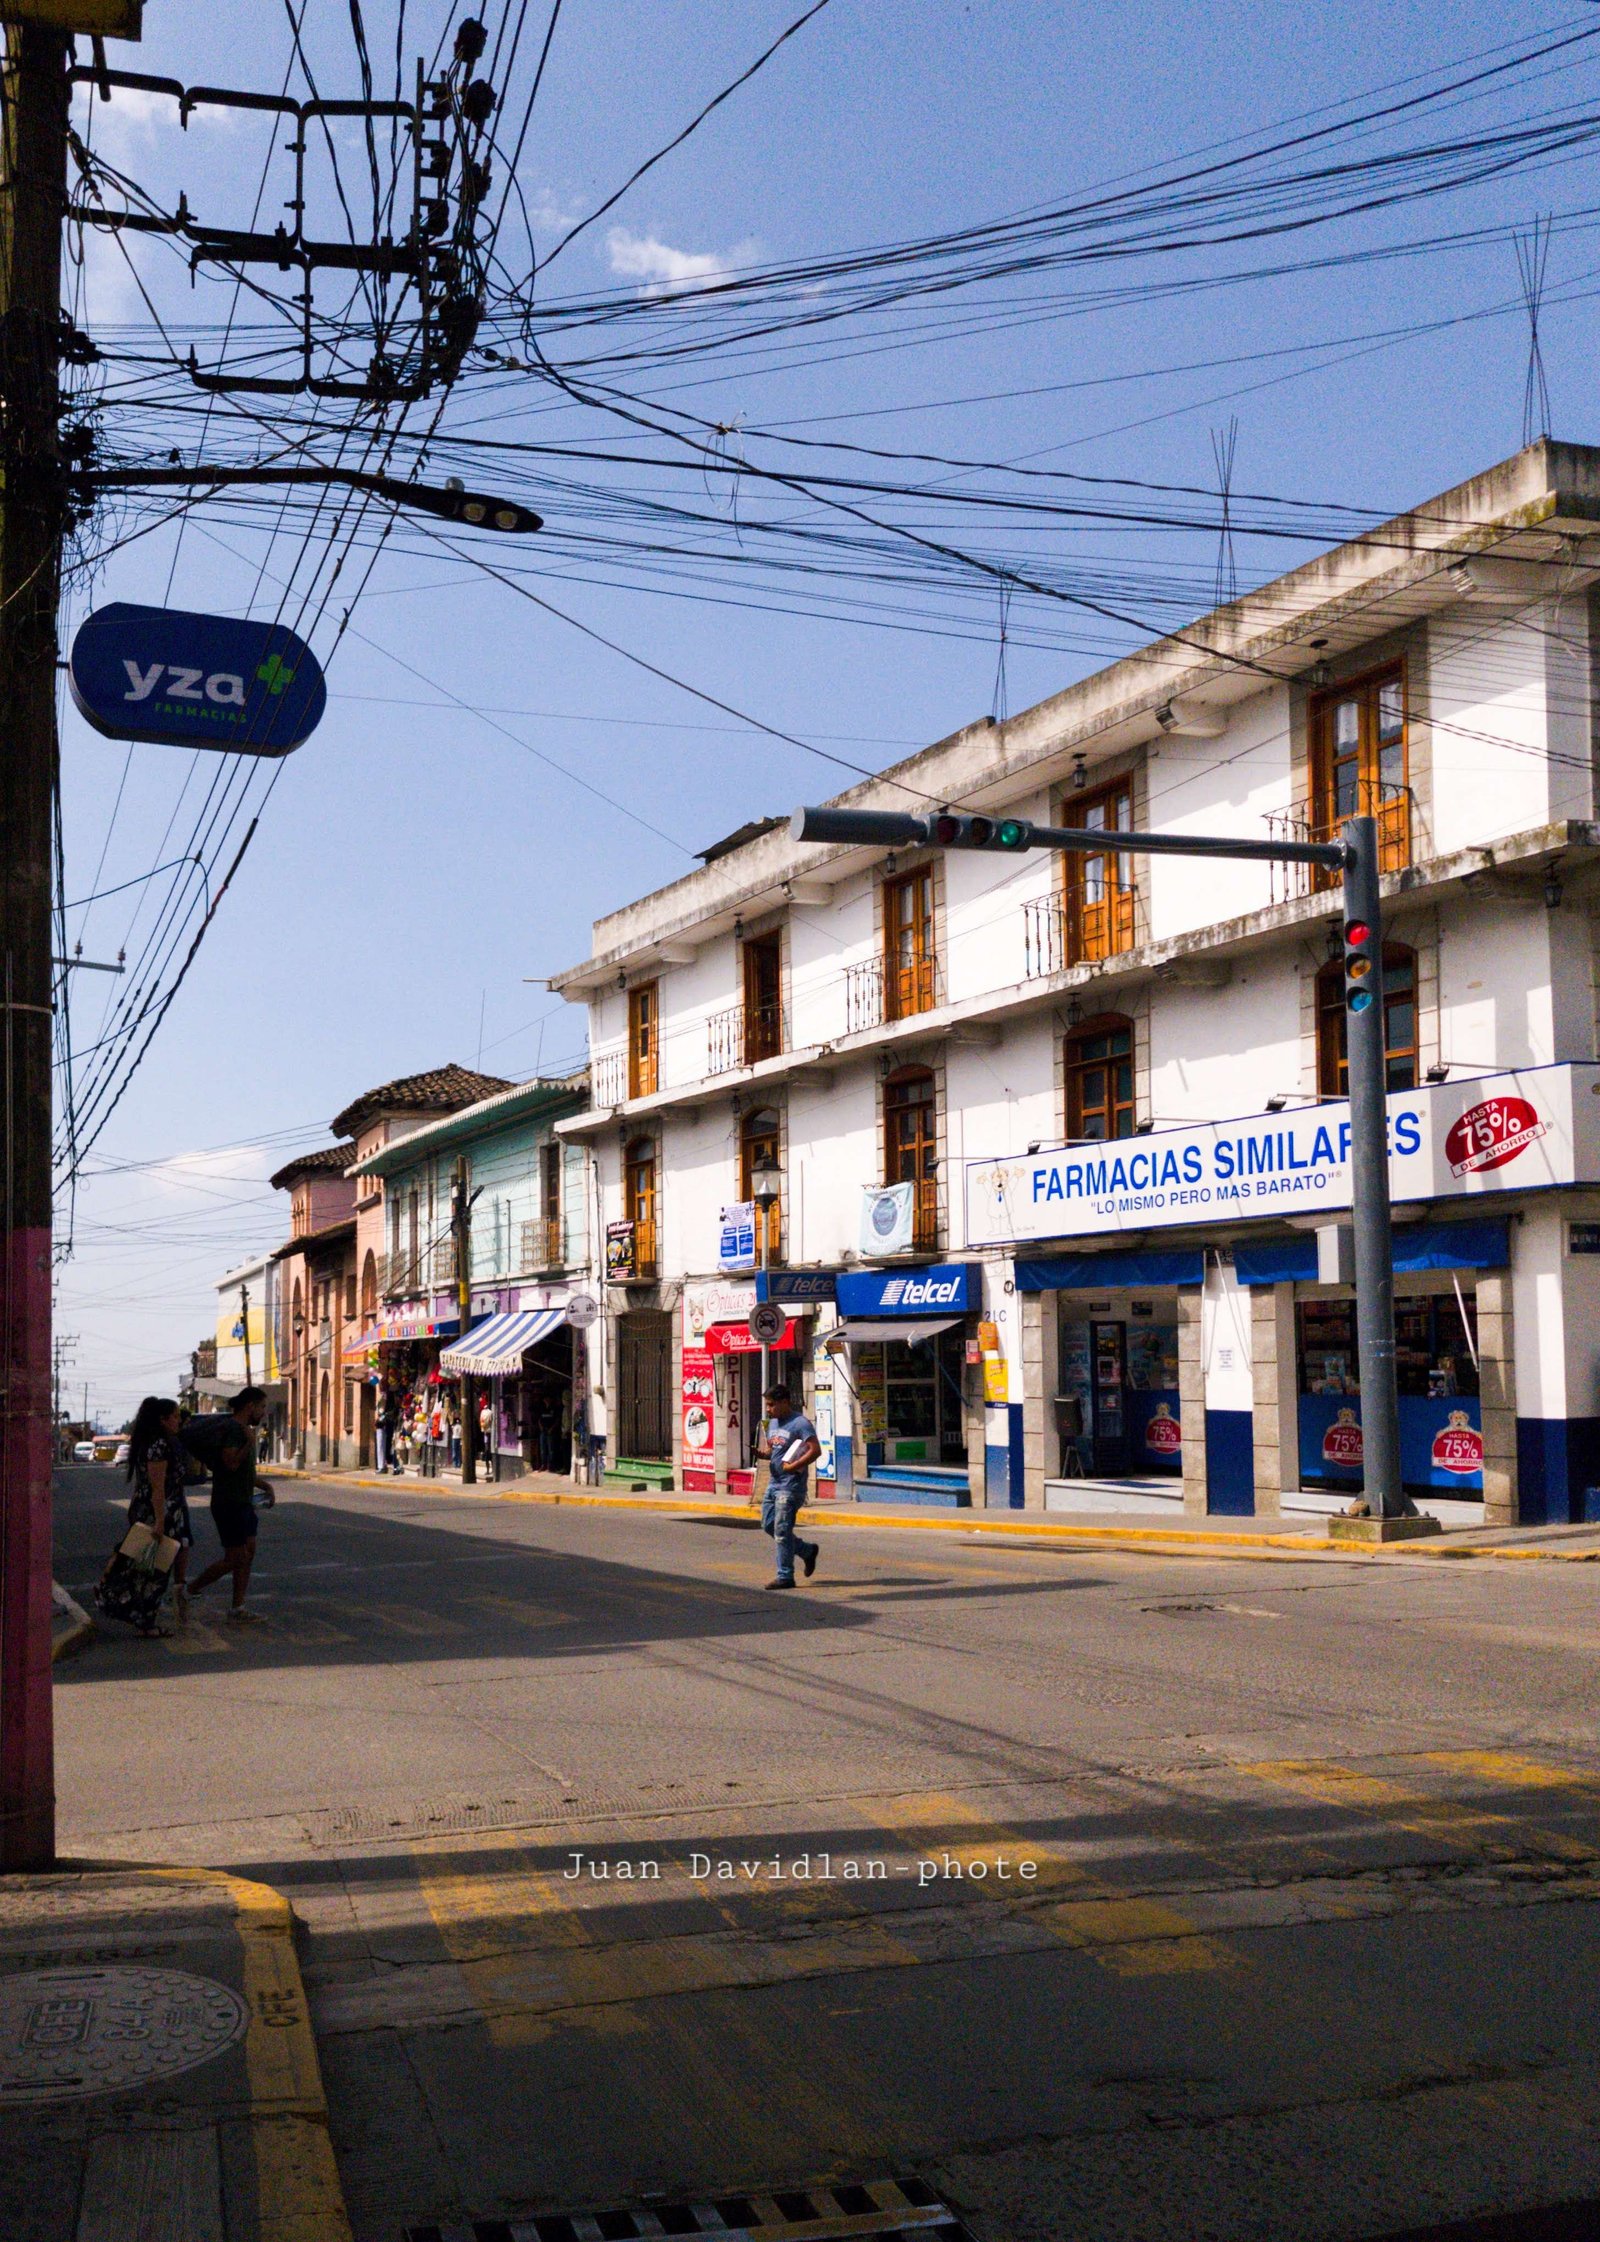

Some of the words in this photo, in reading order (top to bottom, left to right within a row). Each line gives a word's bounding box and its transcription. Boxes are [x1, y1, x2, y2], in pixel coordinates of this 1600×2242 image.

[122, 659, 246, 706] yza
[155, 703, 247, 723] FARMACIAS
[1463, 1101, 1499, 1125] HASTA
[1457, 1106, 1521, 1156] 75%
[1460, 1158, 1477, 1172] DE
[1485, 1129, 1536, 1160] AHORRO
[1032, 1145, 1202, 1203] FARMACIAS
[1119, 1193, 1165, 1212] MISMO
[1170, 1188, 1211, 1207] PERO
[1217, 1183, 1251, 1201] MAS
[902, 1277, 961, 1305] telcel
[727, 1354, 740, 1429] PTICA
[1152, 1426, 1177, 1441] 75%
[1332, 1435, 1363, 1452] 75%
[1443, 1439, 1478, 1458] 75%
[32, 2000, 86, 2044] CFE
[257, 1988, 301, 2028] CFE
